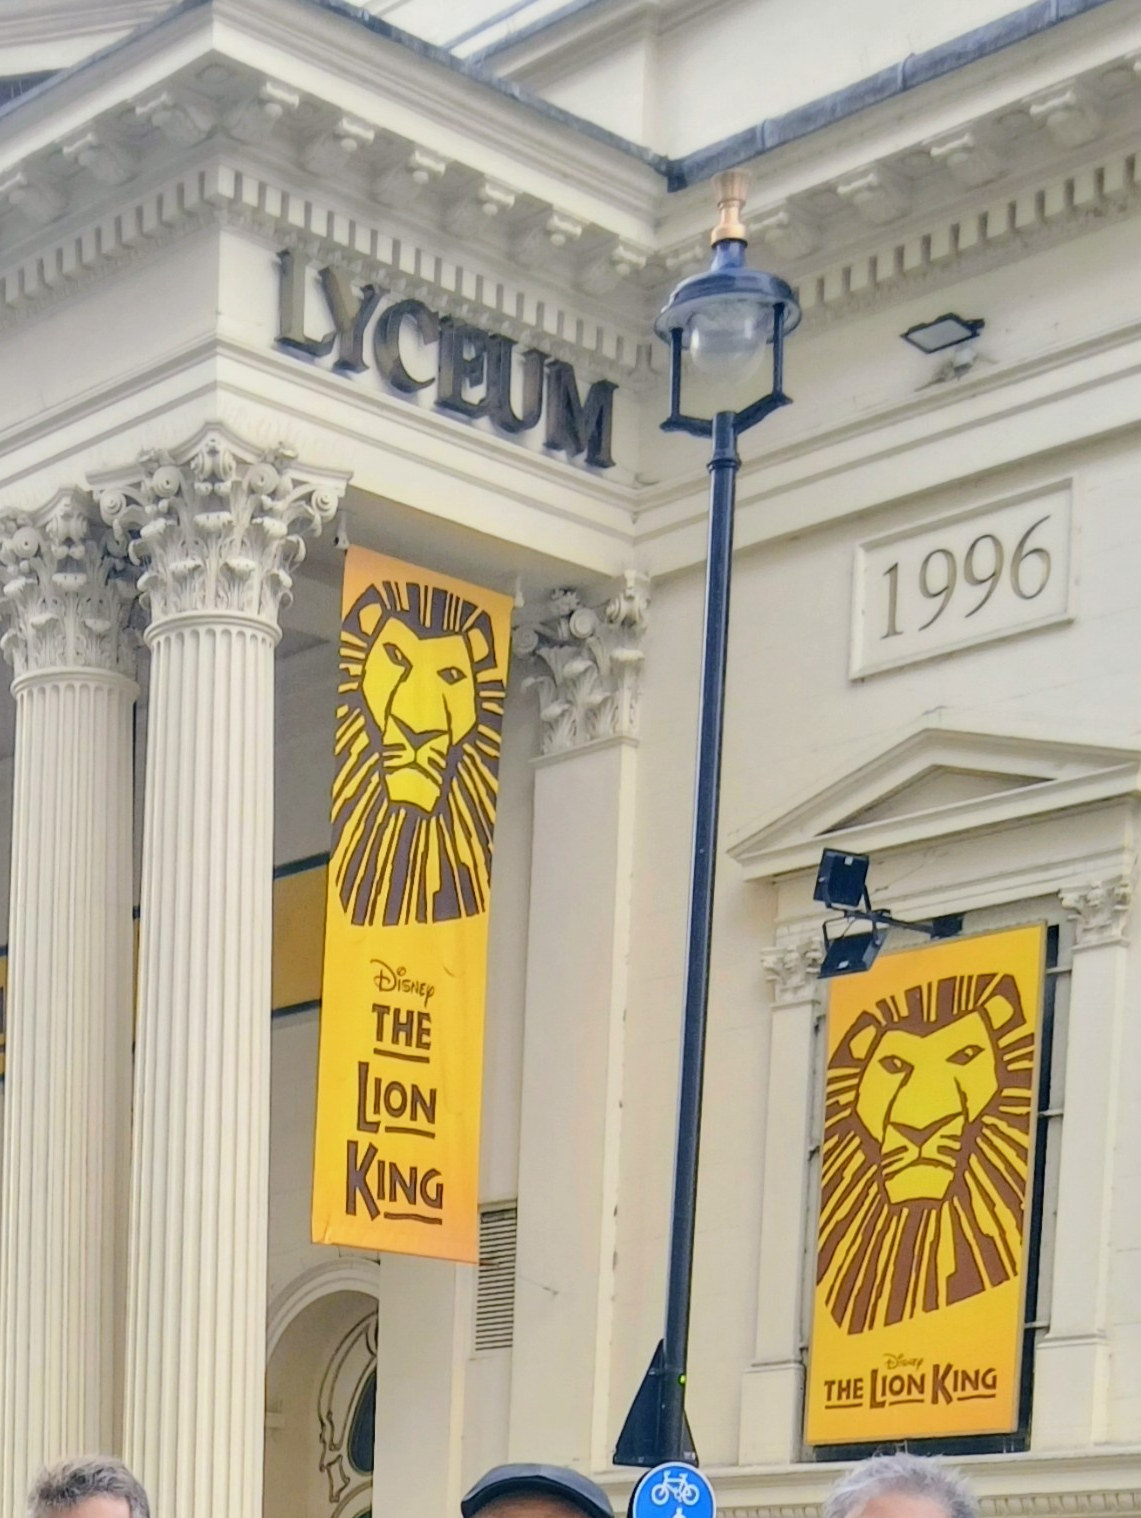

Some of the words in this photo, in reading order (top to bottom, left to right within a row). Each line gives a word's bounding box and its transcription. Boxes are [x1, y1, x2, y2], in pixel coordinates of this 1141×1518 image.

[275, 248, 619, 468] LYCEUM
[880, 514, 1051, 640] 1996
[371, 1002, 431, 1050] THE
[356, 1060, 437, 1134] LION
[345, 1139, 444, 1221] KING
[824, 1377, 864, 1402] THE
[869, 1368, 926, 1409] LION
[931, 1362, 998, 1406] KING
